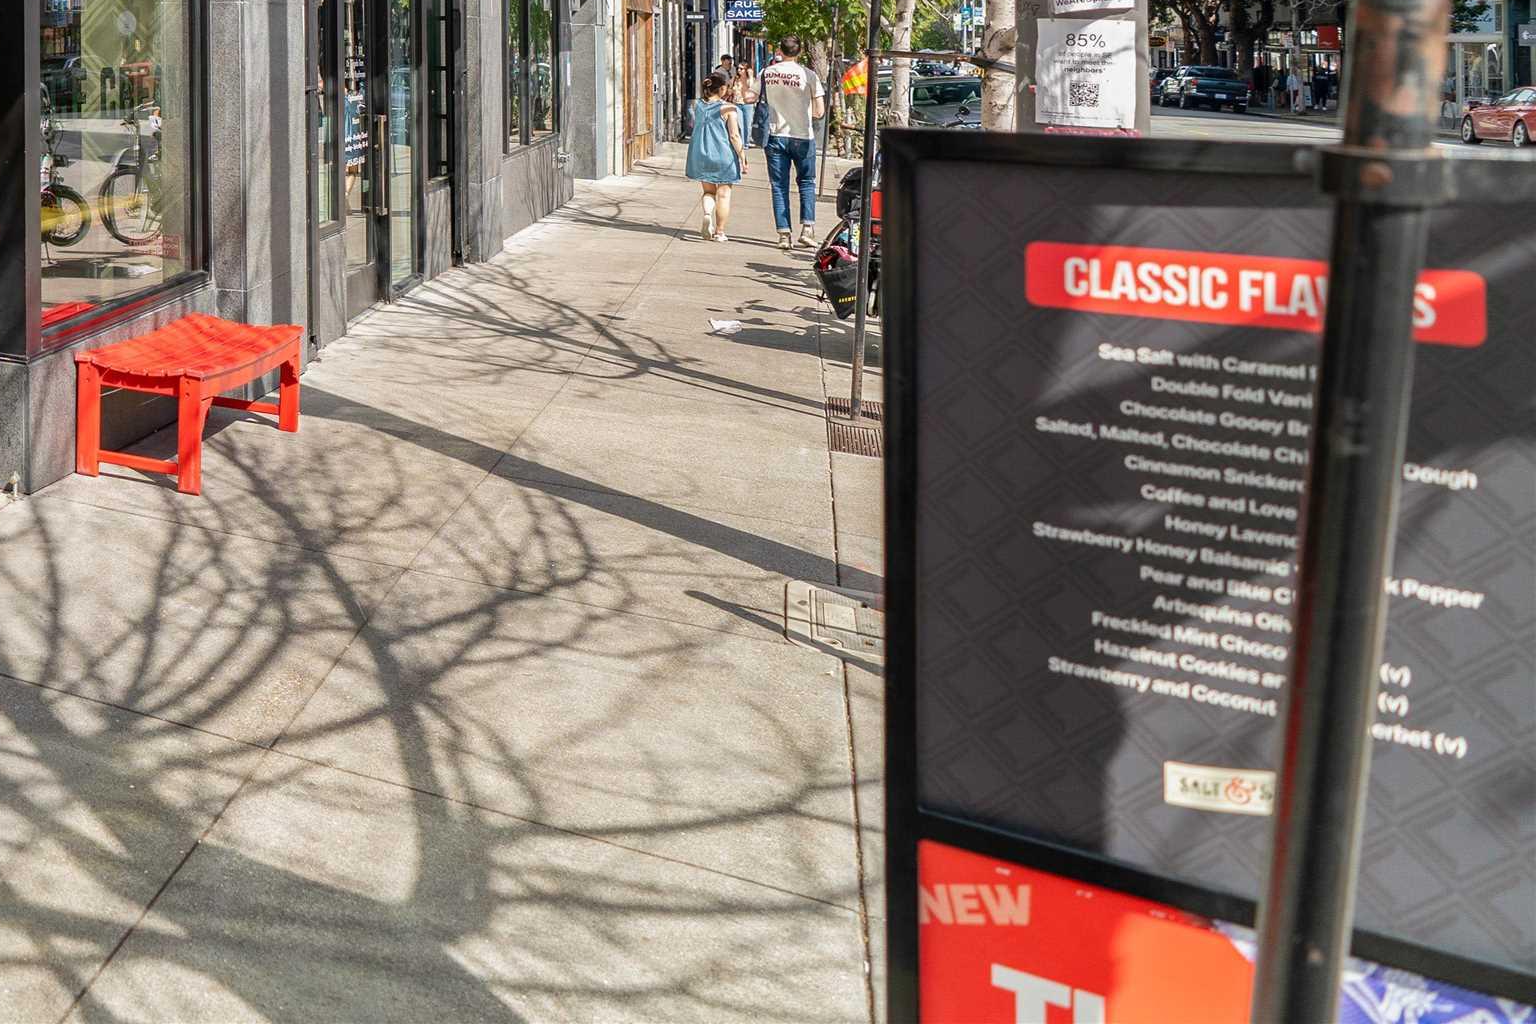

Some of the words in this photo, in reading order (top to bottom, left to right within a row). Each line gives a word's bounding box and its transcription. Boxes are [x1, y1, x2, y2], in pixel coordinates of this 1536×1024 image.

[727, 10, 763, 18] SAKE
[1066, 33, 1106, 48] 85%
[1064, 256, 1229, 310] CLASSIC
[1098, 342, 1136, 363] Sea
[1137, 346, 1175, 365] Salt
[1177, 353, 1220, 371] with
[1222, 357, 1305, 380] Caramel
[1151, 377, 1220, 398] Double
[1222, 384, 1264, 404] Fold
[1120, 400, 1216, 426] Chocolate
[1219, 412, 1284, 436] Gooey
[1035, 416, 1097, 440] Salted,
[1100, 425, 1169, 448] Malted,
[1171, 433, 1271, 461] Chocolate
[1403, 463, 1478, 491] Dough
[1124, 455, 1221, 481] Cinnamon
[1140, 484, 1205, 508] Coffee
[1208, 496, 1246, 514] and
[1165, 515, 1227, 540] Honey
[1033, 521, 1133, 554] Strawberry
[1136, 538, 1198, 563] Honey
[1200, 547, 1290, 576] Balsamic
[1402, 578, 1484, 611] Pepper
[1140, 566, 1185, 587] Pear
[1187, 576, 1224, 594] and
[1227, 579, 1271, 602] Blue
[1153, 595, 1254, 628] Arbequina
[1091, 611, 1172, 641] Freckled
[1174, 625, 1219, 650] Mint
[1379, 662, 1411, 688] (v)
[1095, 639, 1178, 669] Hazelnut
[1179, 654, 1260, 685] Cookies
[1377, 691, 1409, 717] (v)
[1048, 656, 1150, 693] Strawberry
[1152, 678, 1191, 699] and
[1191, 684, 1278, 717] Coconut
[1434, 732, 1468, 759] (v)
[918, 883, 1031, 927] NEW
